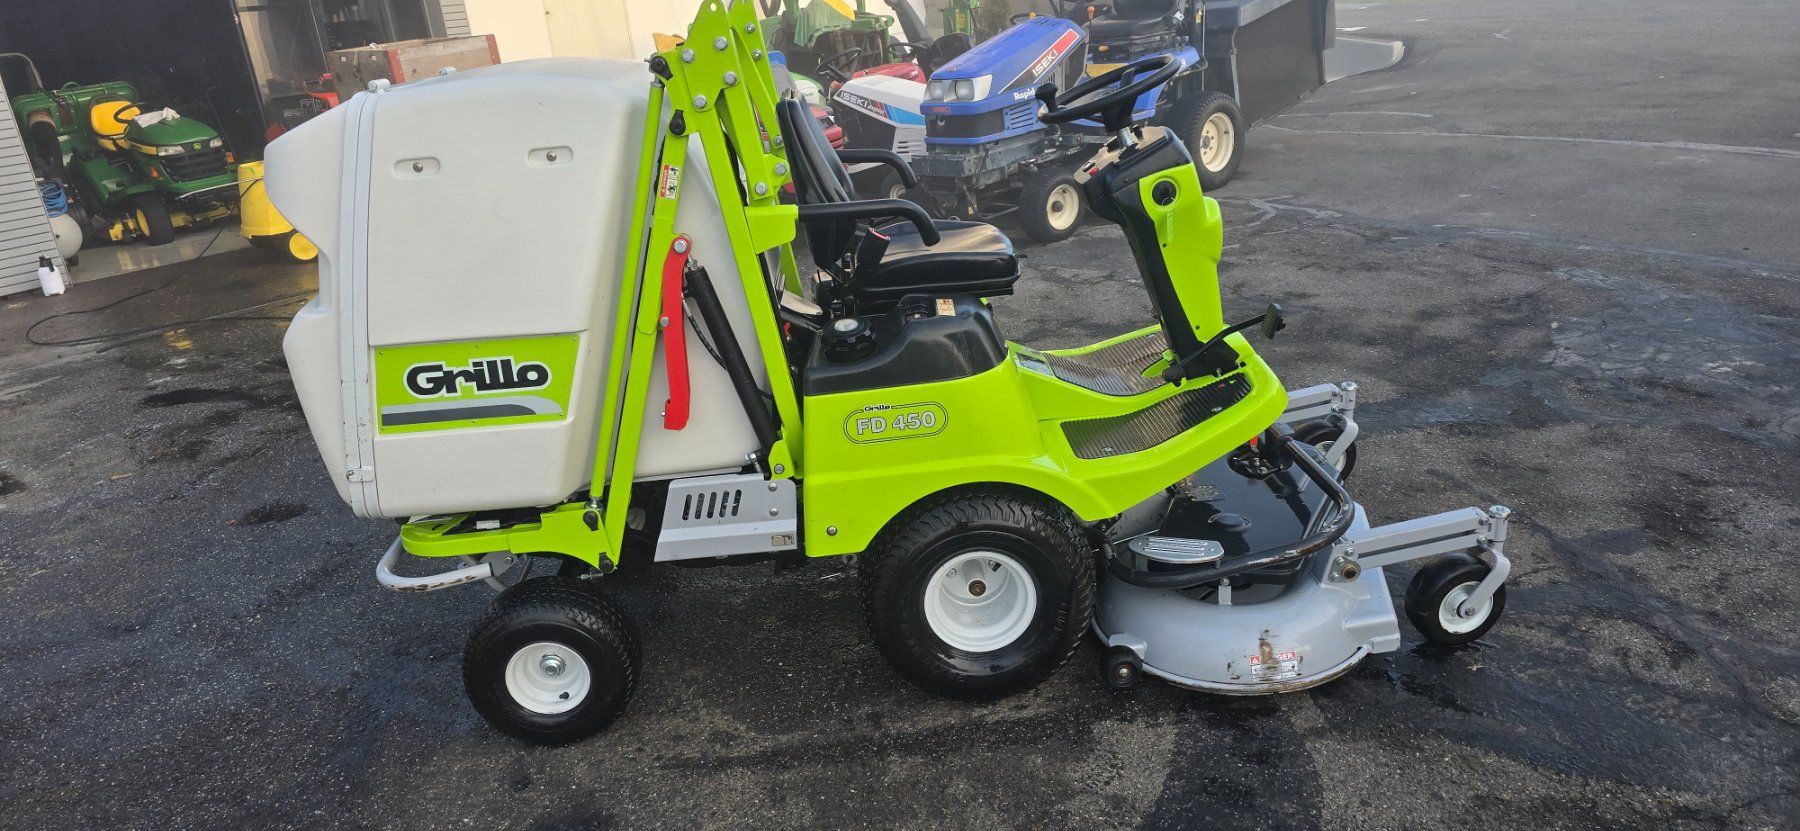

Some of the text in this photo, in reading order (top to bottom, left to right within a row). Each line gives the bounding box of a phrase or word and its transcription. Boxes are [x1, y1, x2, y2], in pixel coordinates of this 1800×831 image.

[1032, 48, 1059, 77] ISEKI
[840, 91, 868, 108] ISEKI
[1013, 87, 1036, 101] Rapid
[404, 357, 551, 397] Grillo
[864, 404, 891, 412] Grillo
[857, 410, 937, 435] FD 450
